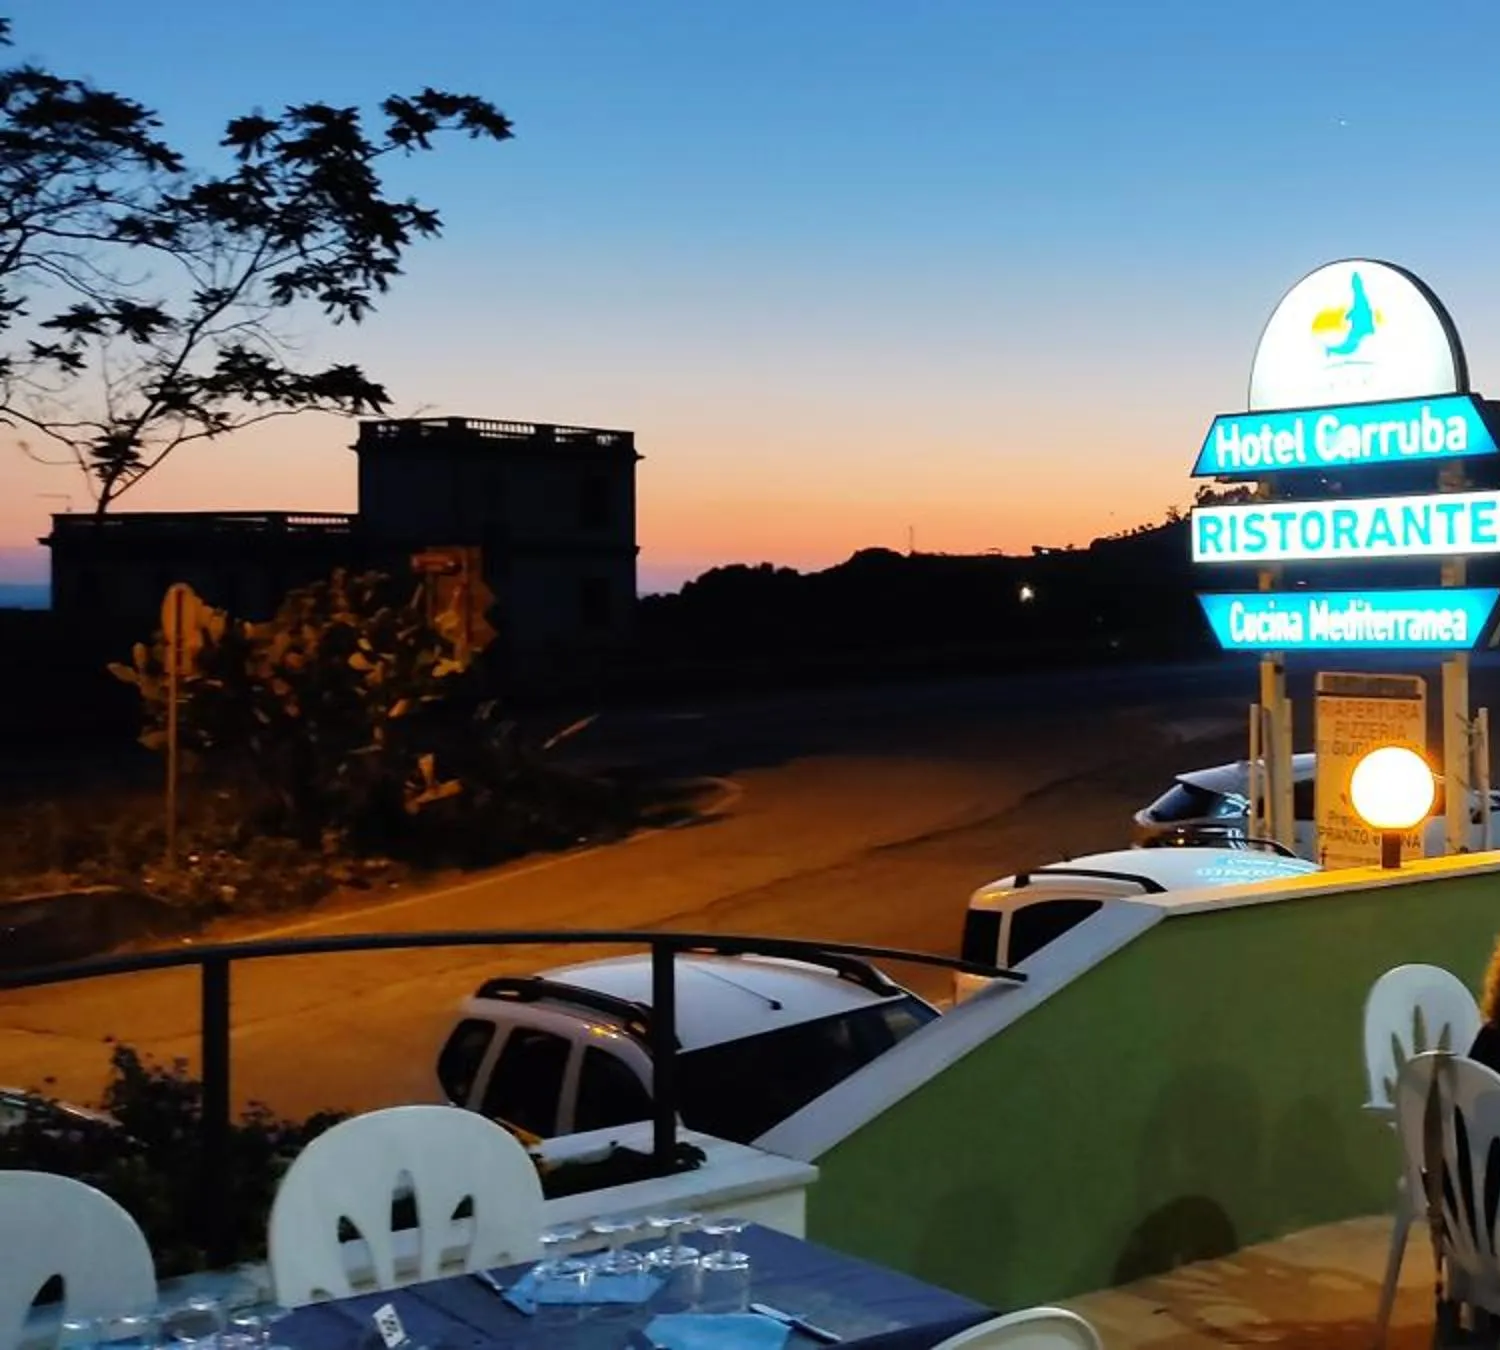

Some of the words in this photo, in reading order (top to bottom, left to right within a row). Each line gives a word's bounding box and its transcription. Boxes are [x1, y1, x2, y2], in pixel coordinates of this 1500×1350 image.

[1215, 418, 1306, 468] Hotel
[1315, 405, 1468, 462] Carruba
[1198, 501, 1497, 554] RISTORANTE
[1230, 600, 1303, 642] Cucina
[1309, 597, 1467, 642] Mediterranea
[1319, 700, 1419, 719] RIAPERTURA
[1335, 720, 1407, 740] PIZZERIA
[1317, 826, 1369, 845] PRANZO
